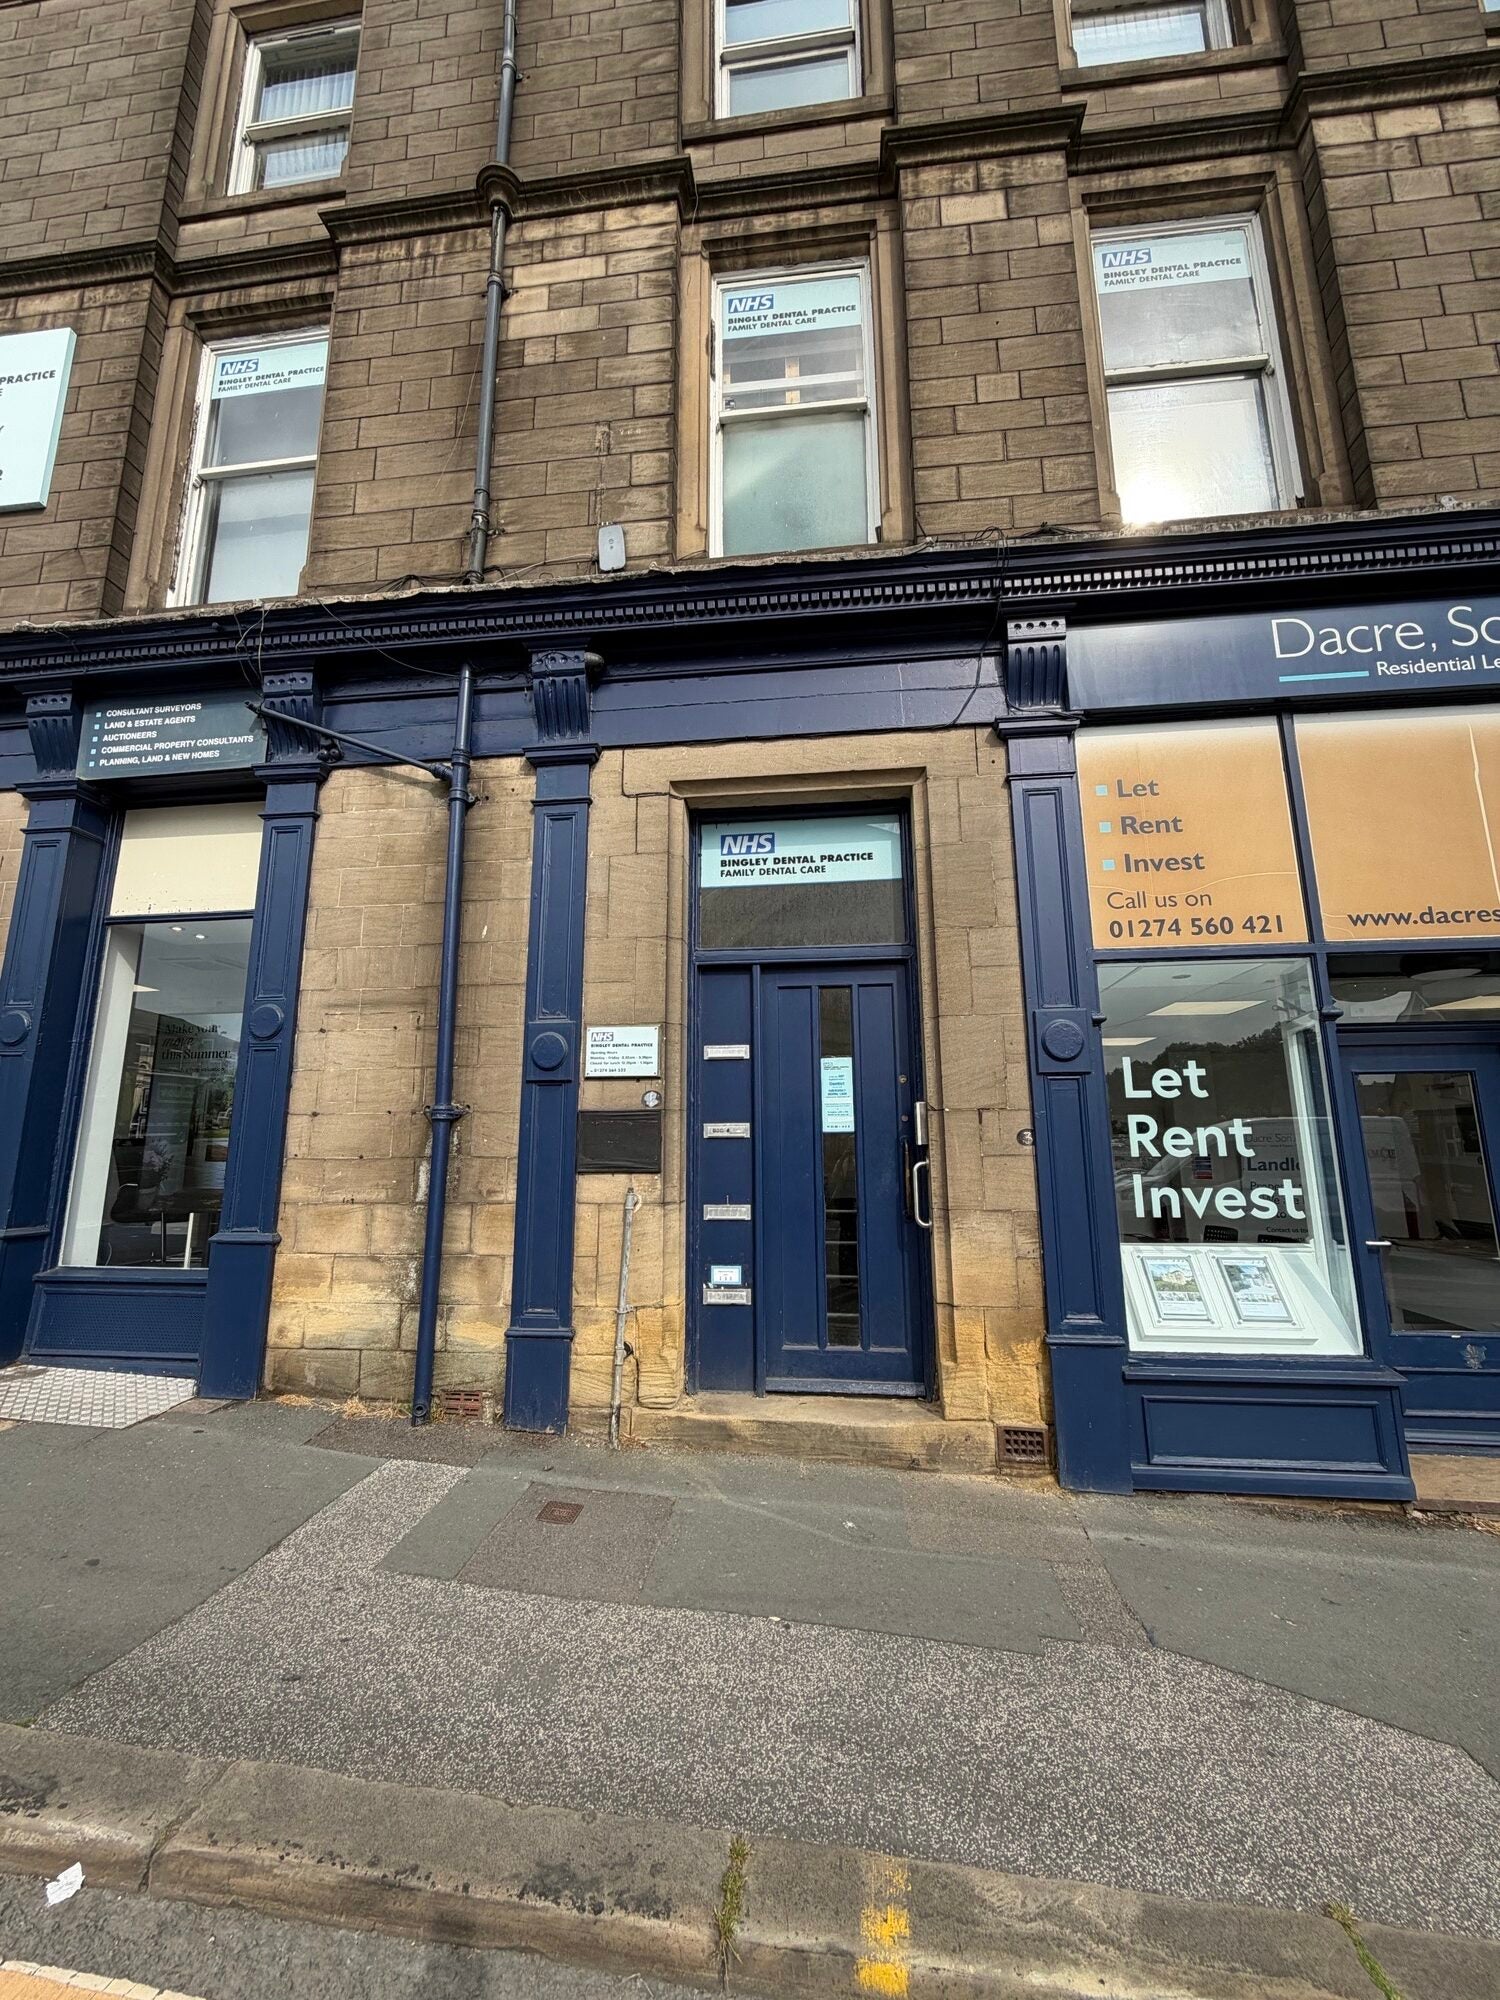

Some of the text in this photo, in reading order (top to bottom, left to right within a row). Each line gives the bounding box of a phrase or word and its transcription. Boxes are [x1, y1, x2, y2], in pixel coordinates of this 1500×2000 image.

[1104, 249, 1150, 267] NHS
[1103, 258, 1241, 279] BINGLEY DENTAL PRACTICE
[1104, 270, 1200, 287] FAMILY DENTAL CARE
[729, 295, 773, 313] NHS
[728, 304, 856, 324] BINGLEY DENTAL PRACTICE
[728, 316, 817, 332] FAMILY DENTAL CARE
[219, 366, 324, 386] BINGLEY DENTAL PRACTICE
[221, 360, 258, 376] NHS
[0, 370, 56, 385] PRACTICE
[244, 381, 271, 389] DENTAL
[1271, 618, 1437, 658] Dacre,
[1376, 654, 1476, 676] Residential
[106, 703, 202, 718] CONSULTANT SURVEYORS
[104, 716, 196, 730] LAND & ESTATE AGENTS
[101, 736, 254, 754] COMMERCIAL PROPERTY CONSULTANTS
[103, 731, 158, 742] AUCTIONEERS
[100, 750, 220, 767] PLANNING, LAND & NEW HOMES
[1116, 779, 1160, 798] Let
[1120, 815, 1184, 835] Rent
[722, 834, 773, 855] NHS
[720, 852, 874, 868] BINGLEY DENTAL PRACTICE
[1124, 852, 1206, 873] Invest
[720, 865, 826, 878] FAMILY DENTAL CARE
[1106, 890, 1212, 910] Call us on
[1109, 914, 1283, 938] 01274 560 421
[592, 1032, 613, 1042] NHS
[1122, 1056, 1209, 1099] Let
[1127, 1114, 1257, 1158] Rent
[1133, 1174, 1307, 1220] Invest
